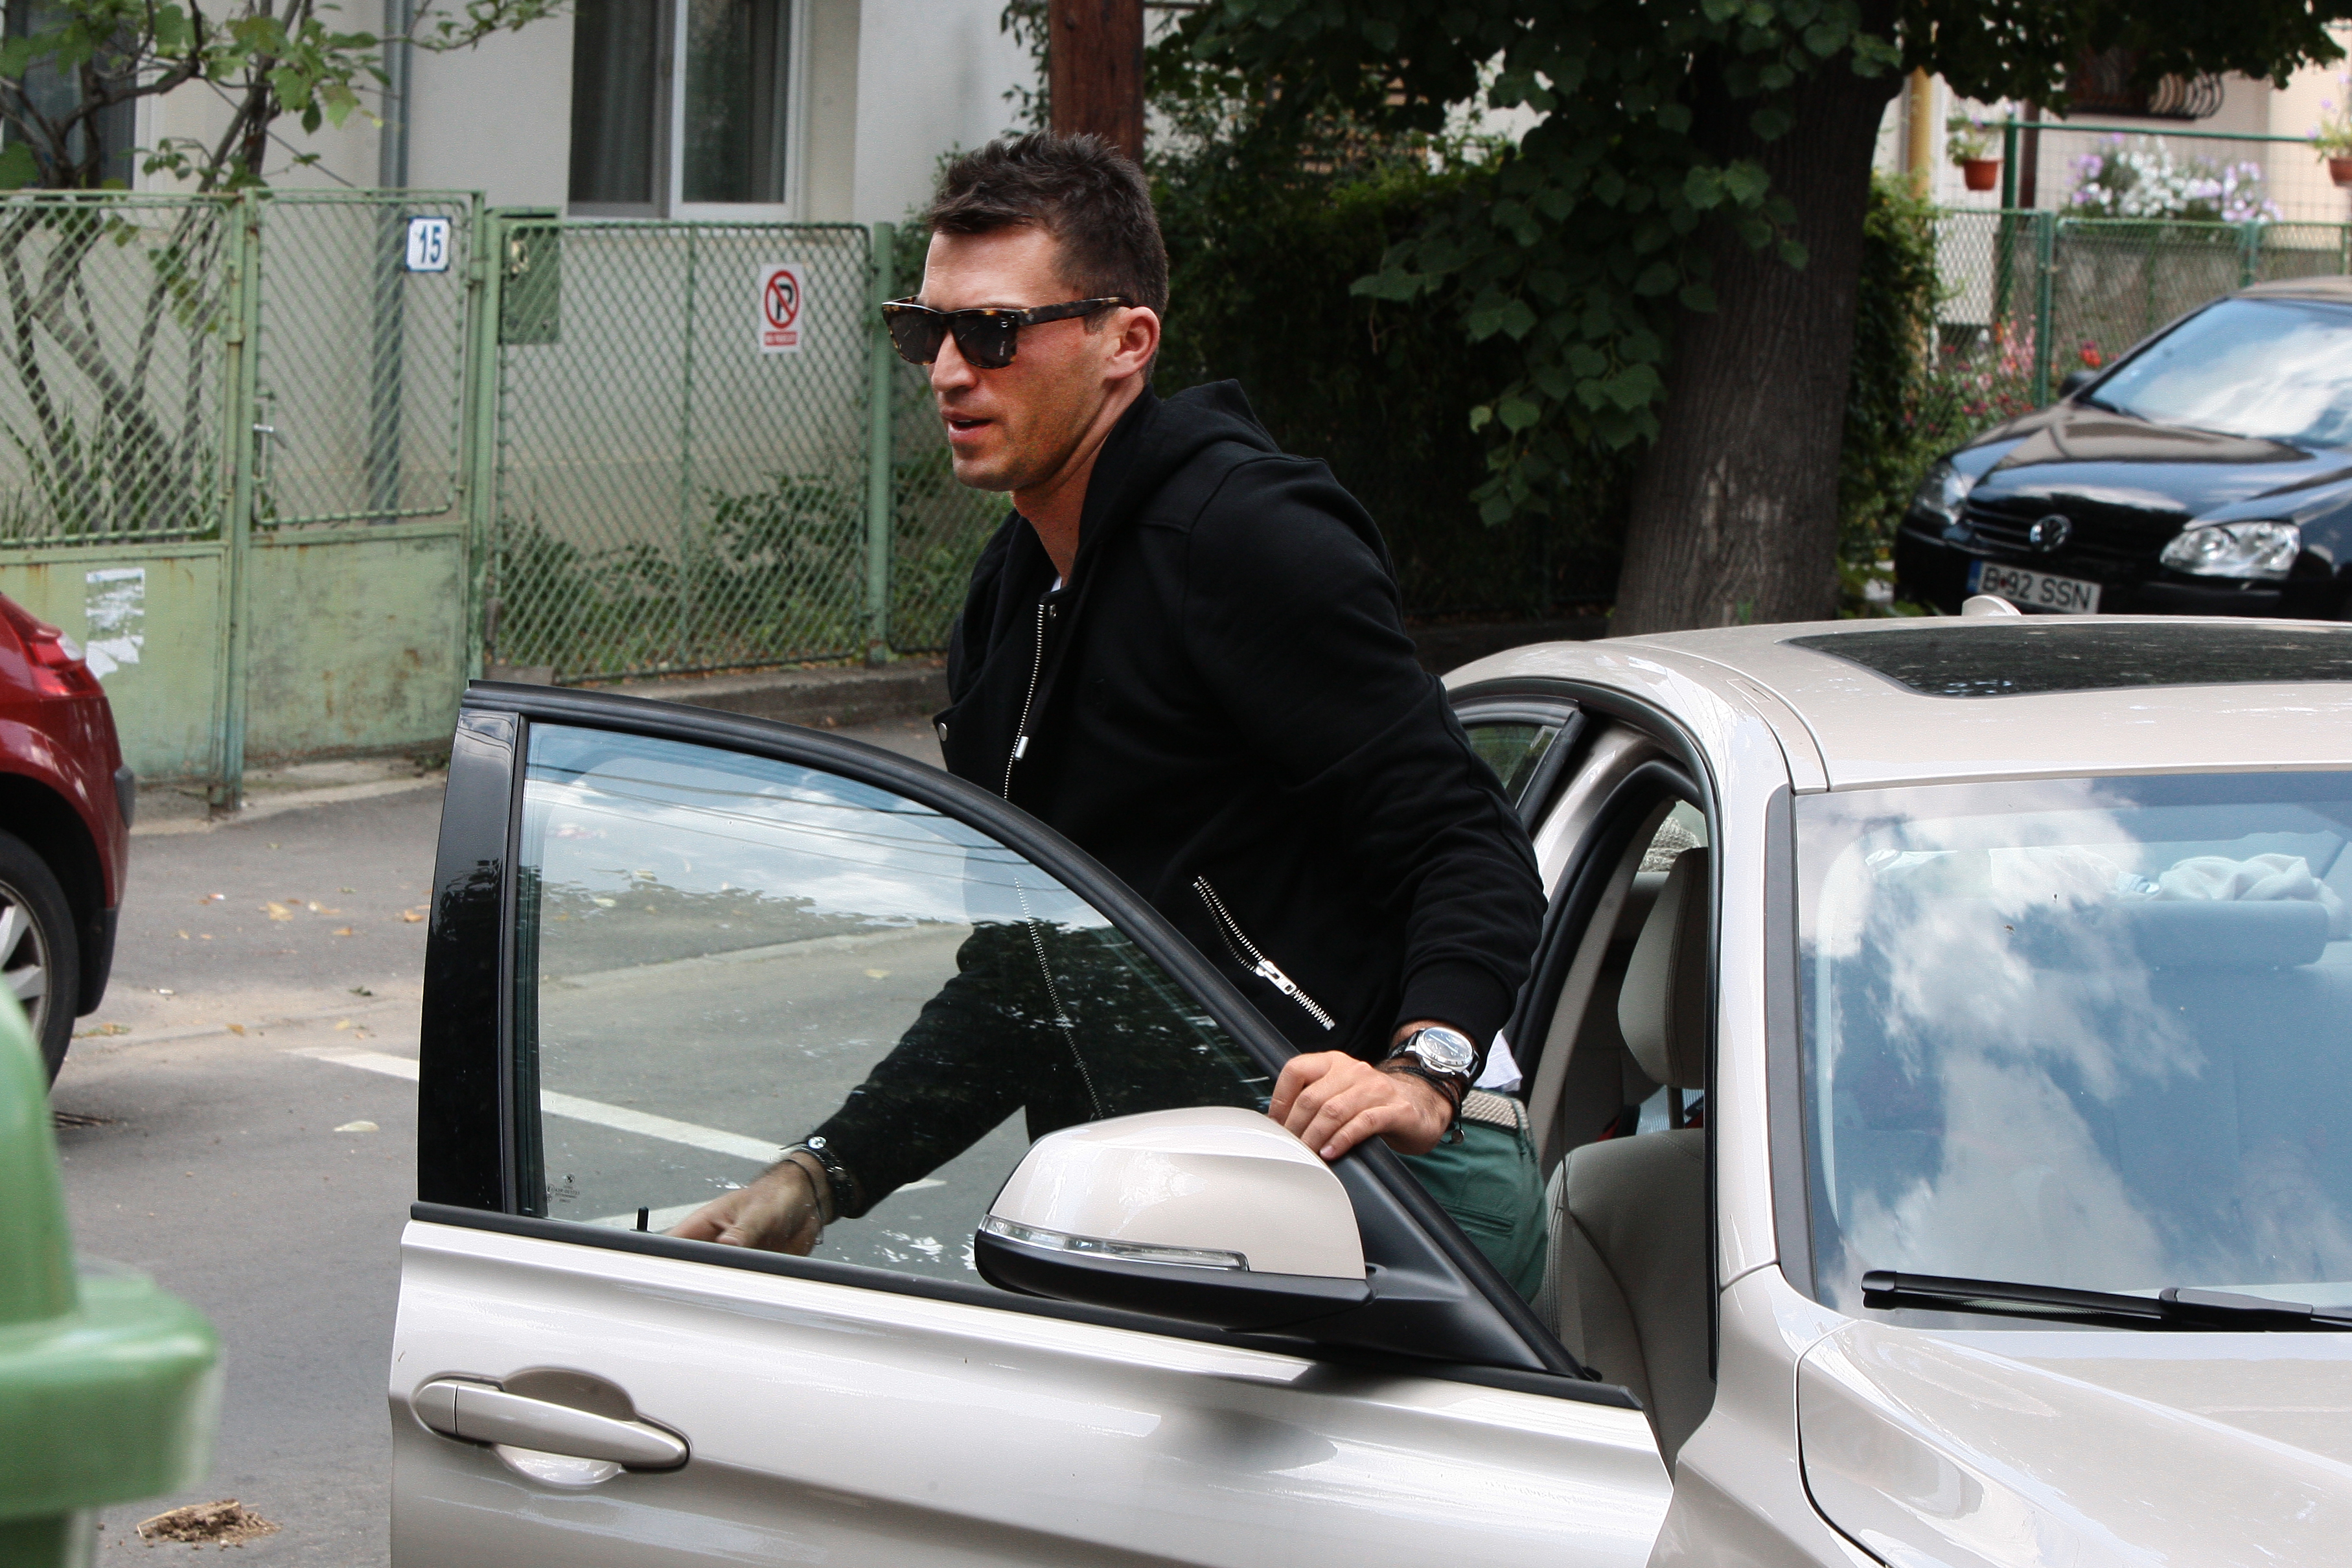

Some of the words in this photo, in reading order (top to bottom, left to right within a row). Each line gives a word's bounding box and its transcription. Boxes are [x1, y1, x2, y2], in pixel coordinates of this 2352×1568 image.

[420, 225, 441, 263] 15
[776, 284, 793, 320] P
[1982, 566, 2000, 592] B
[2006, 571, 2033, 599] 92
[2039, 577, 2092, 610] SSN
